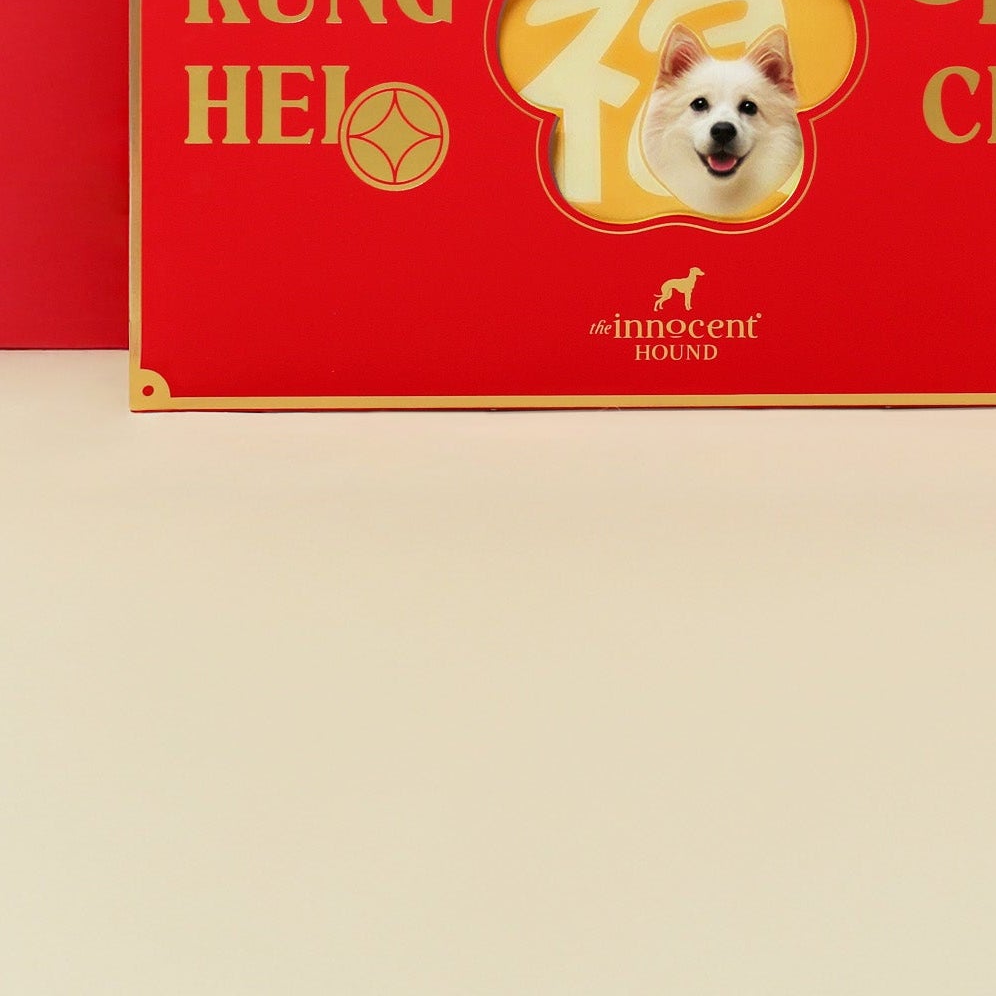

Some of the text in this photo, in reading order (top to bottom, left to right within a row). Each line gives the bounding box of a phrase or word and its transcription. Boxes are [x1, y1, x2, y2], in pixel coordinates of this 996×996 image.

[184, 65, 350, 144] HEI
[589, 312, 758, 339] the innocent
[634, 344, 718, 361] HOUND
